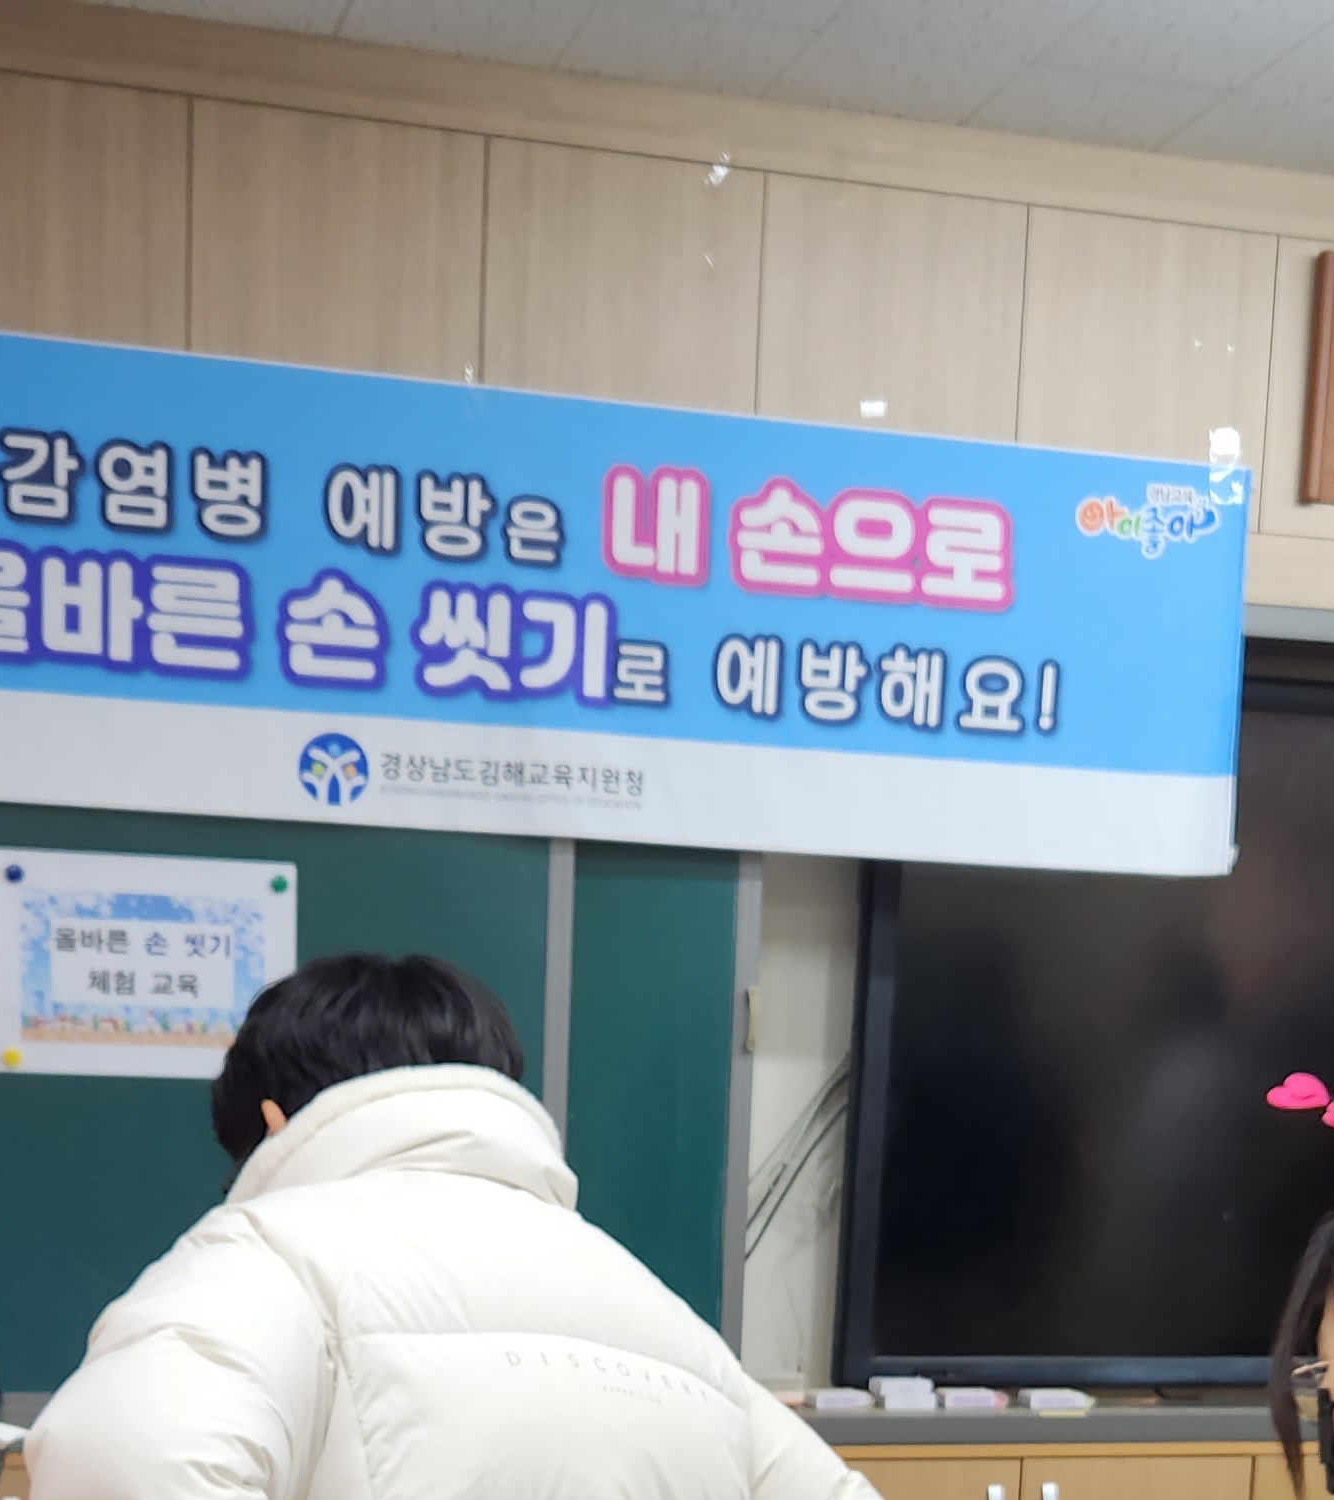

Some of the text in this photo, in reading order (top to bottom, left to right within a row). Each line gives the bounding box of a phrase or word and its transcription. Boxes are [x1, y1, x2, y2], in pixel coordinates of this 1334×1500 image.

[324, 463, 566, 567] 예방은
[605, 468, 708, 584] 내
[731, 479, 1011, 609] 손으로
[280, 568, 387, 687] 손
[414, 580, 668, 706] 씻기로
[713, 633, 1061, 735] 예방해요!
[379, 752, 644, 796] 경상남도김해교육지원청
[55, 927, 231, 959] 올바른 손 씻기
[88, 969, 199, 998] 체험 교육
